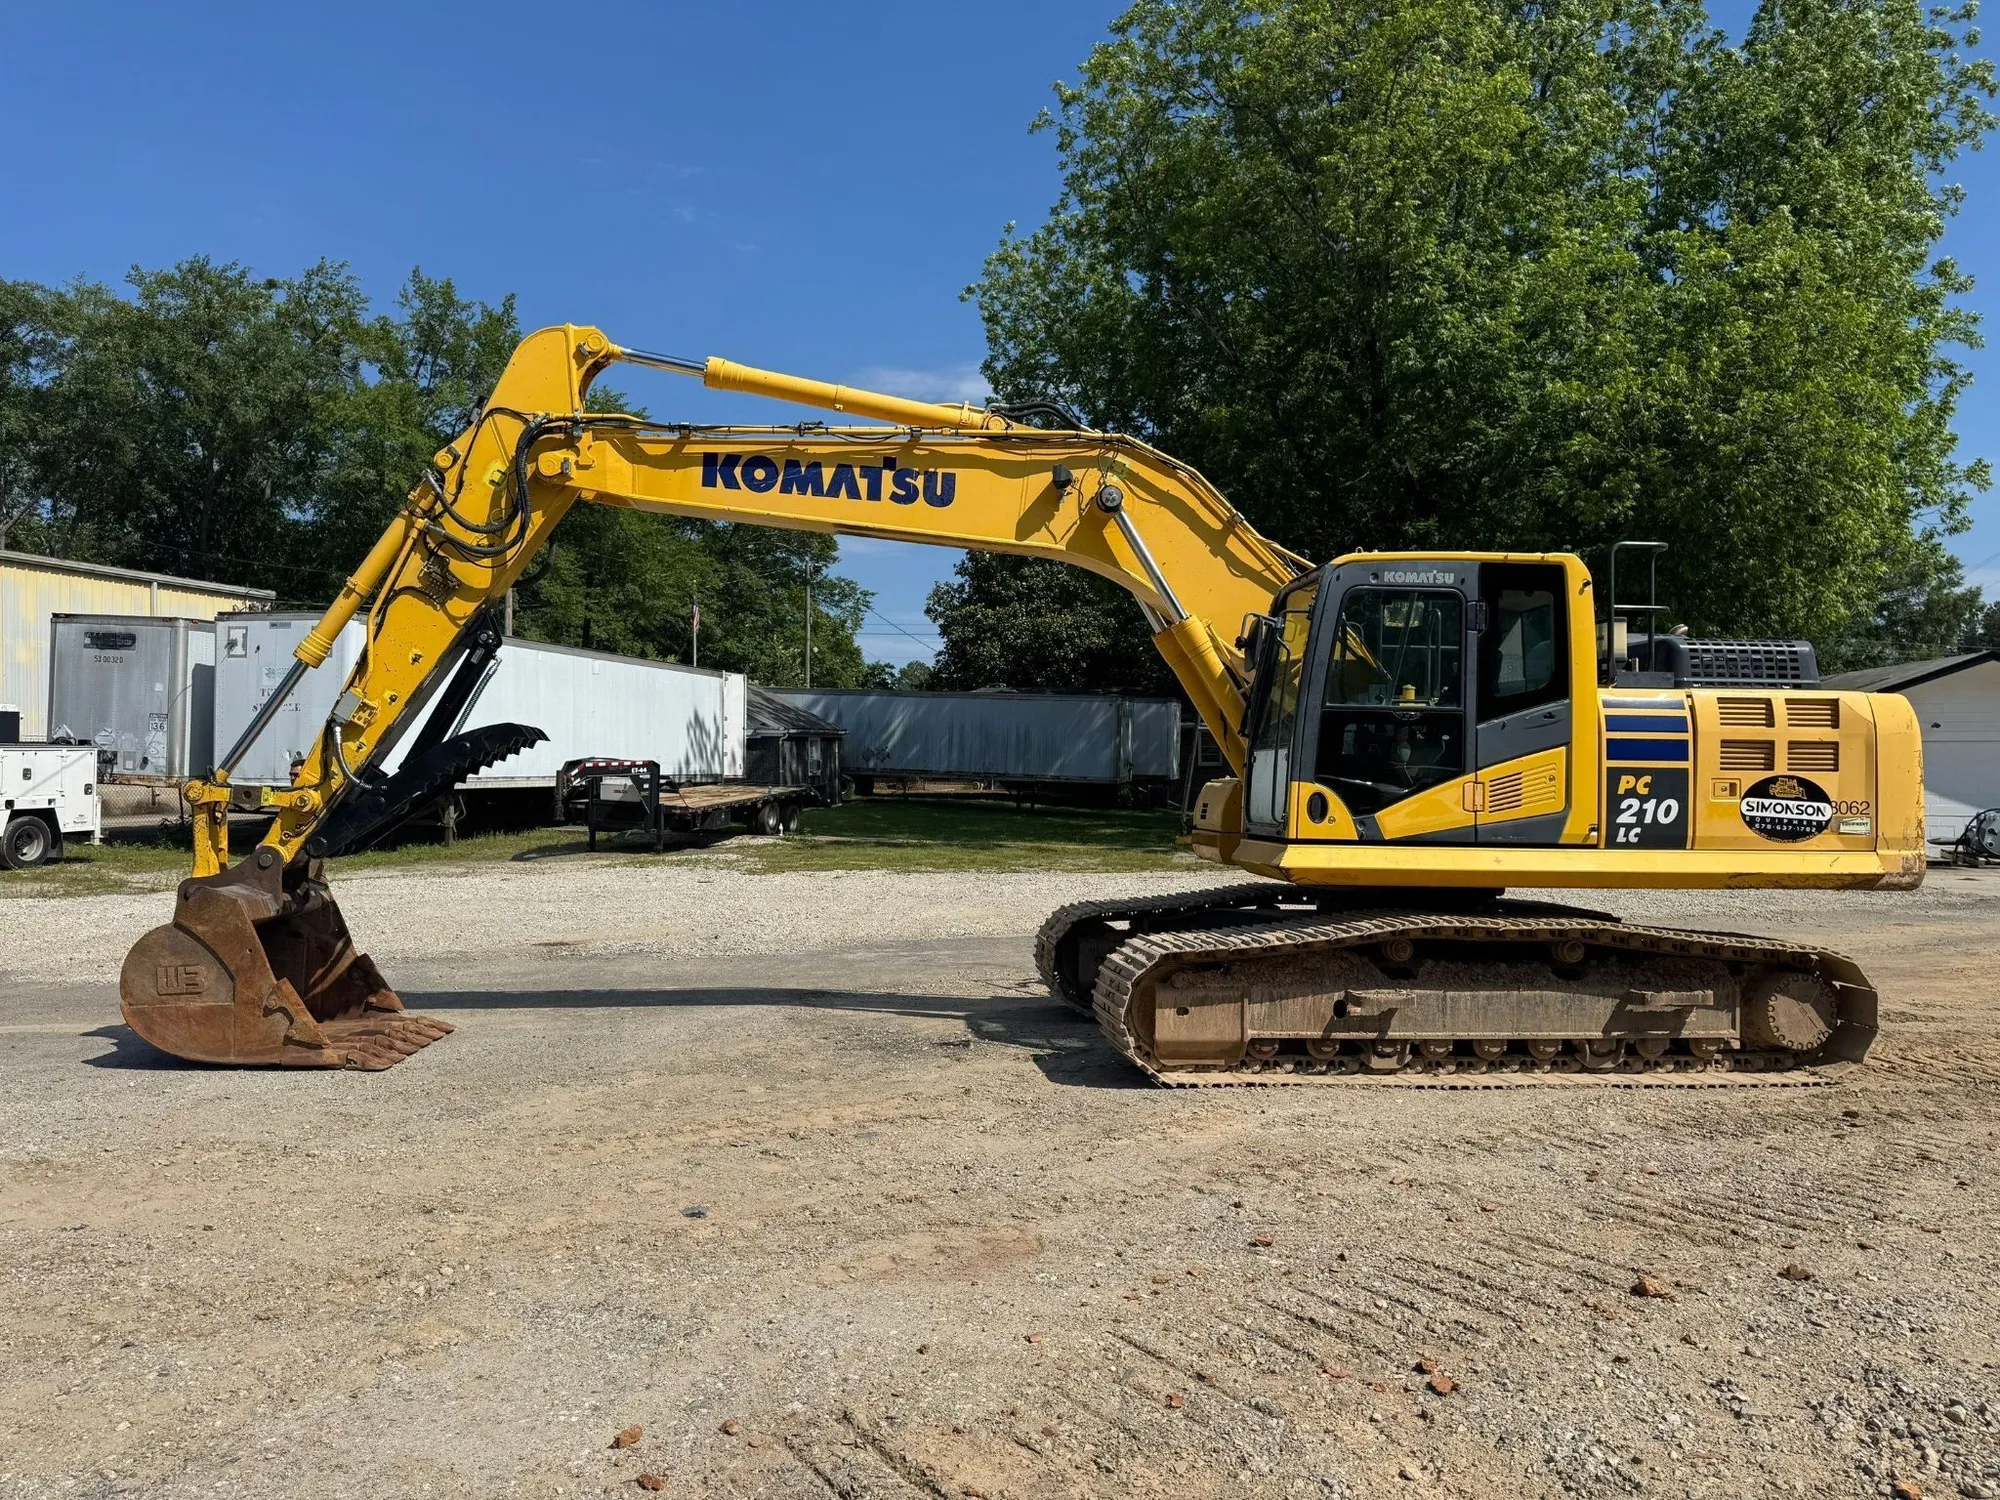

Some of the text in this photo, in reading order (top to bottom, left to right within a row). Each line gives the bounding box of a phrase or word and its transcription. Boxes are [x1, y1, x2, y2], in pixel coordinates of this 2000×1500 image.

[702, 452, 956, 508] KOMATSU
[1384, 570, 1454, 585] KOMATSU
[1617, 775, 1652, 794] PC
[1615, 798, 1679, 824] 210
[1745, 800, 1826, 817] SIMONSON
[1745, 816, 1826, 826] EQUIPMENT
[1615, 827, 1642, 843] LC
